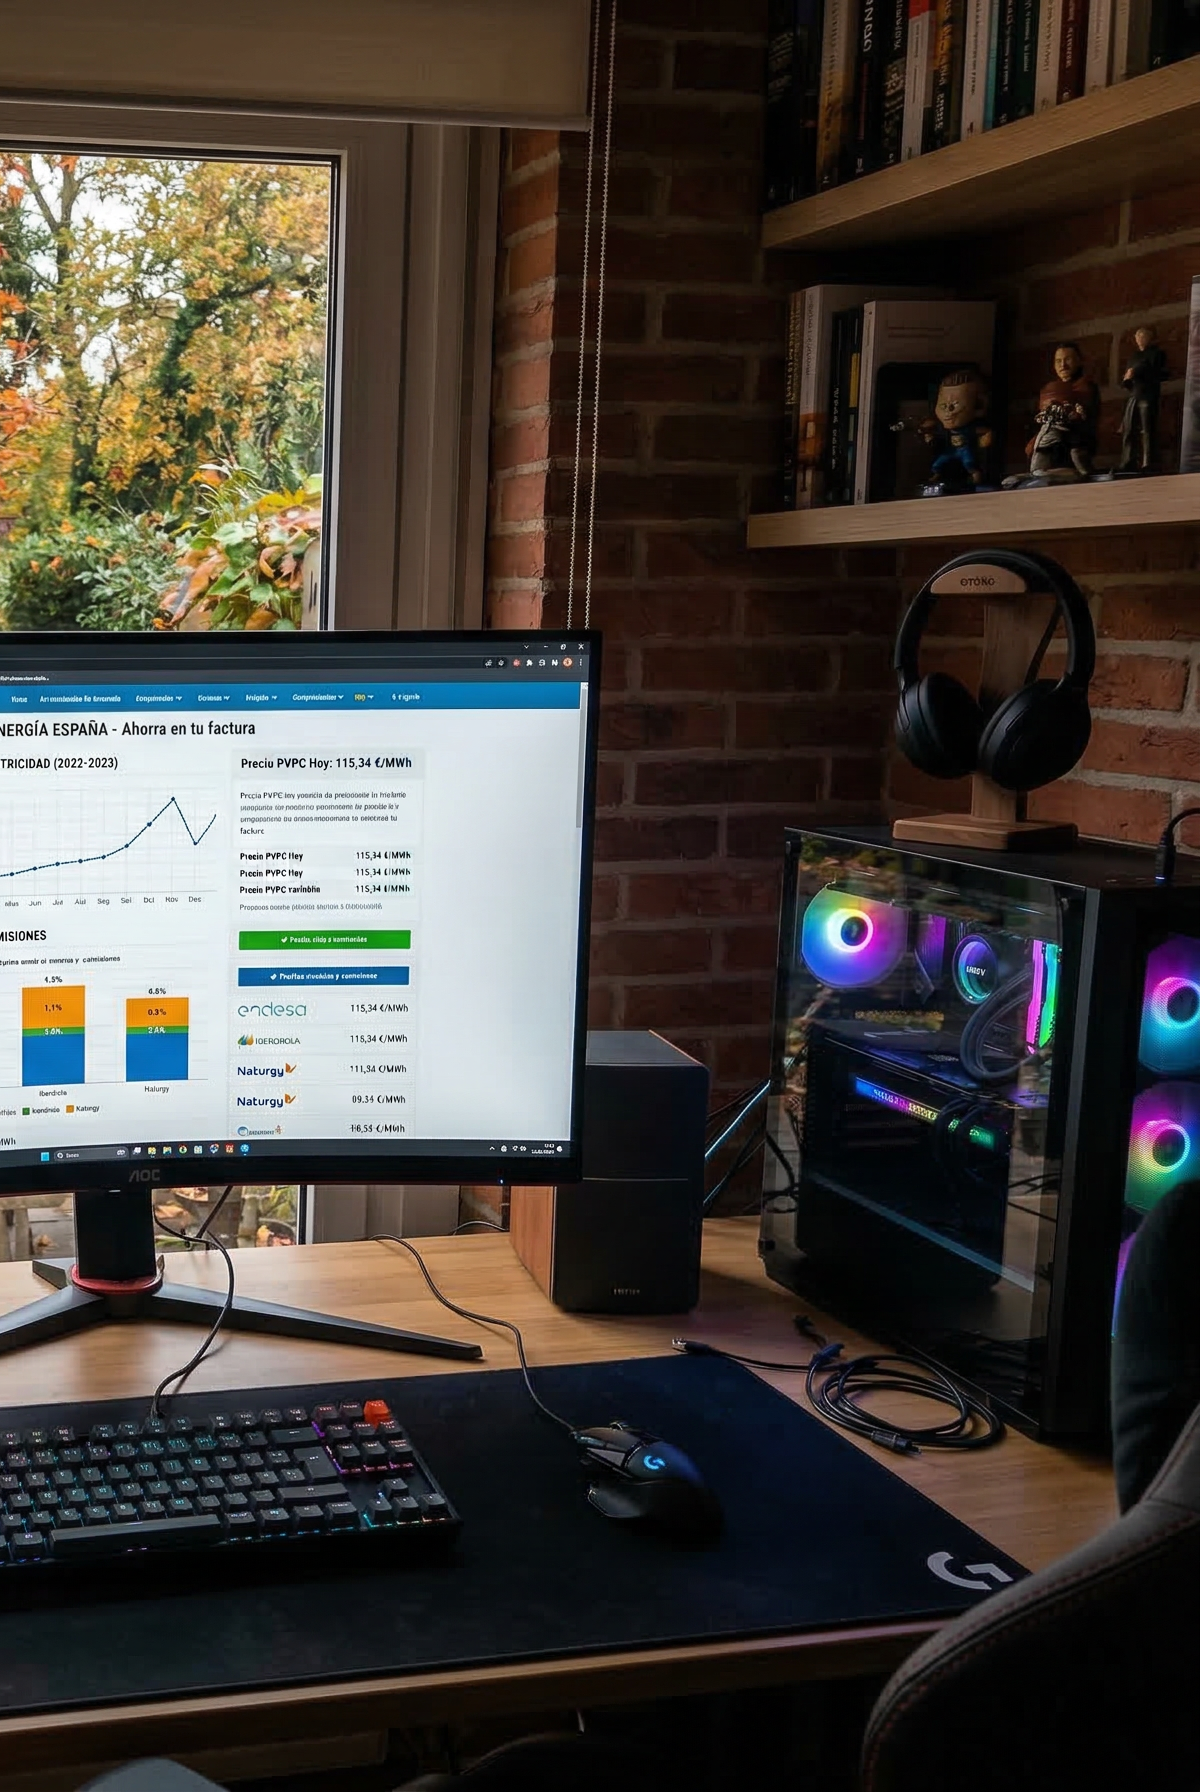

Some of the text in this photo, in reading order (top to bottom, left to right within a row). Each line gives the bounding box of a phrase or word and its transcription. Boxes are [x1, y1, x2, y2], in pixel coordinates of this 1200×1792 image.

[53, 719, 108, 737] ESPAÑA
[121, 721, 166, 736] Ahorra
[171, 724, 186, 735] en
[191, 722, 204, 735] tu
[208, 720, 256, 735] factura
[53, 756, 118, 771] (2022-2023)
[277, 758, 306, 768] PVPC
[309, 757, 333, 770] Hoy:
[336, 757, 371, 770] 115,34
[375, 757, 412, 768] €/MWh
[265, 852, 287, 860] PVPC
[356, 851, 381, 861] 115,34
[265, 869, 287, 877] PVPC
[238, 1002, 307, 1017] endesa
[351, 1004, 377, 1014] 115,34
[237, 1066, 284, 1077] Naturgy
[237, 1097, 284, 1108] Naturgy
[128, 1169, 160, 1182] AOC
